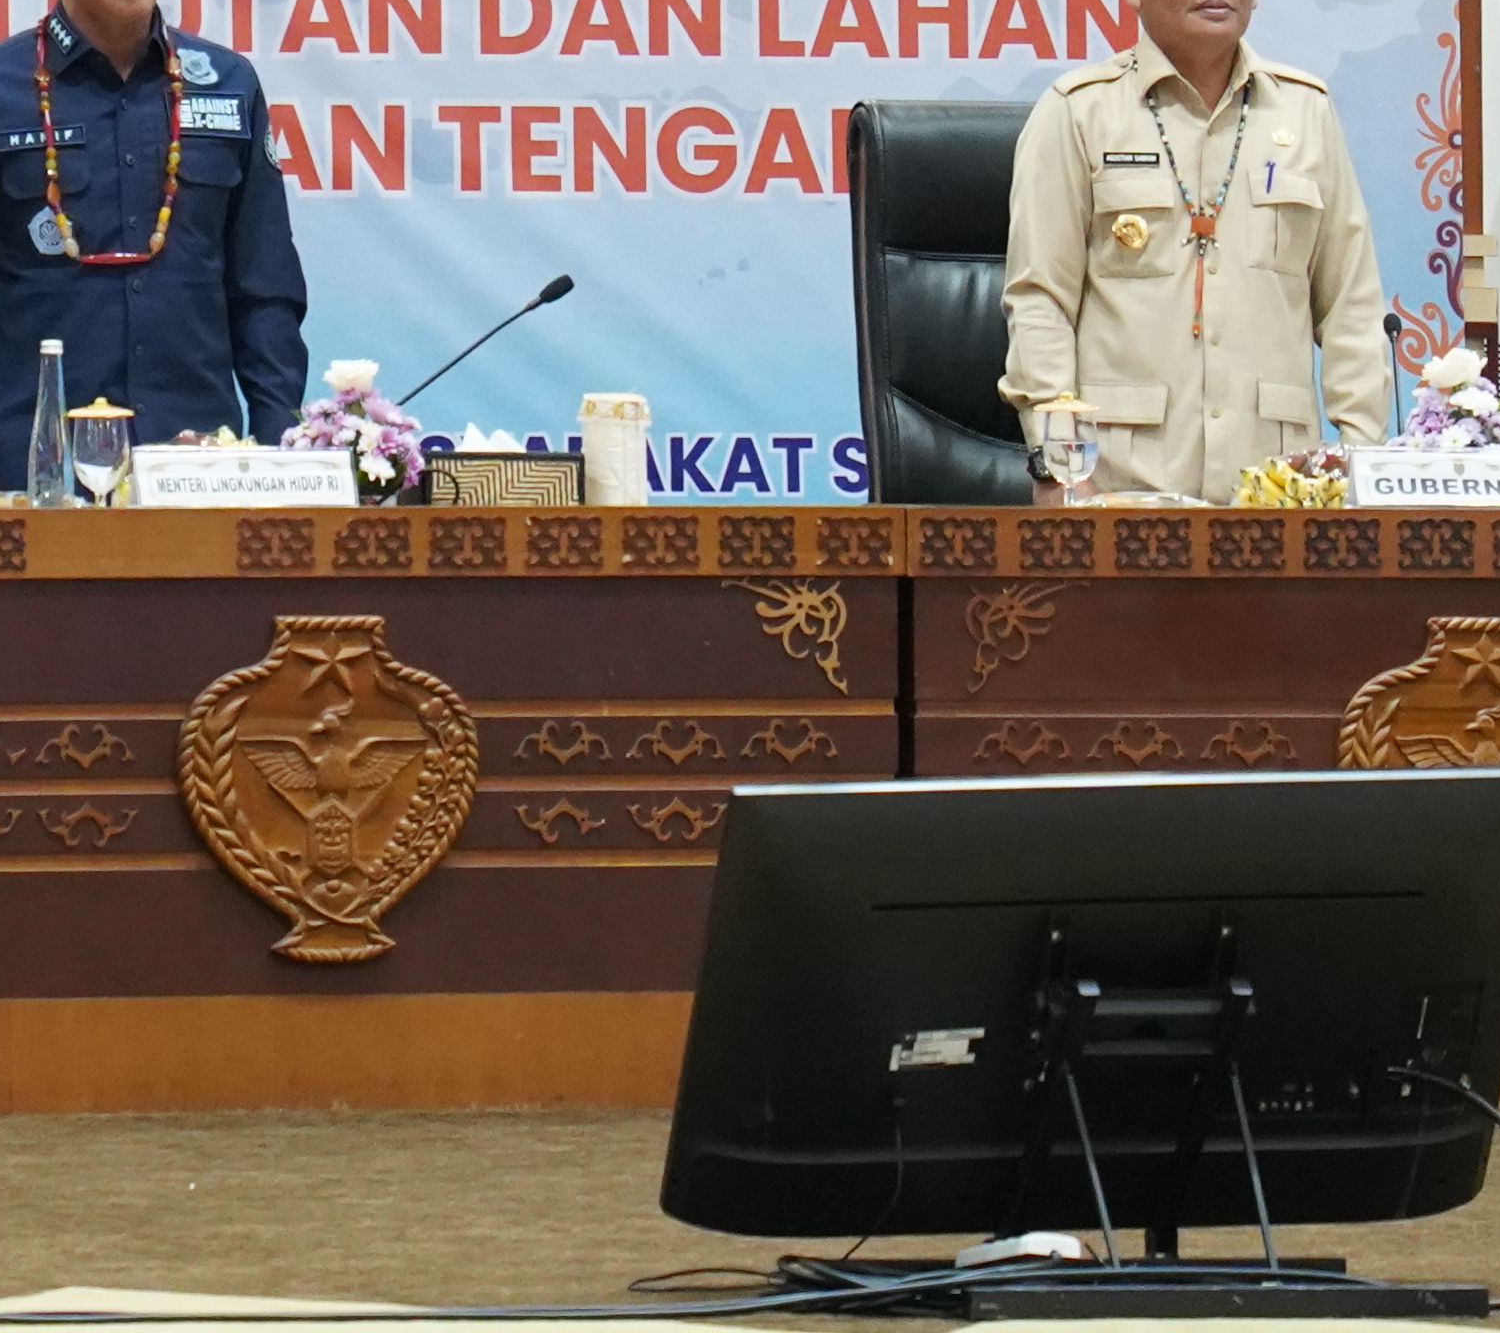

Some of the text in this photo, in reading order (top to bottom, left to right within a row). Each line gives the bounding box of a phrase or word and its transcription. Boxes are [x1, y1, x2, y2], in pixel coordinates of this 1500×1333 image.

[191, 97, 239, 115] AGAINST
[156, 475, 339, 494] MENTERI LINGKUNGAN HIDUP RI
